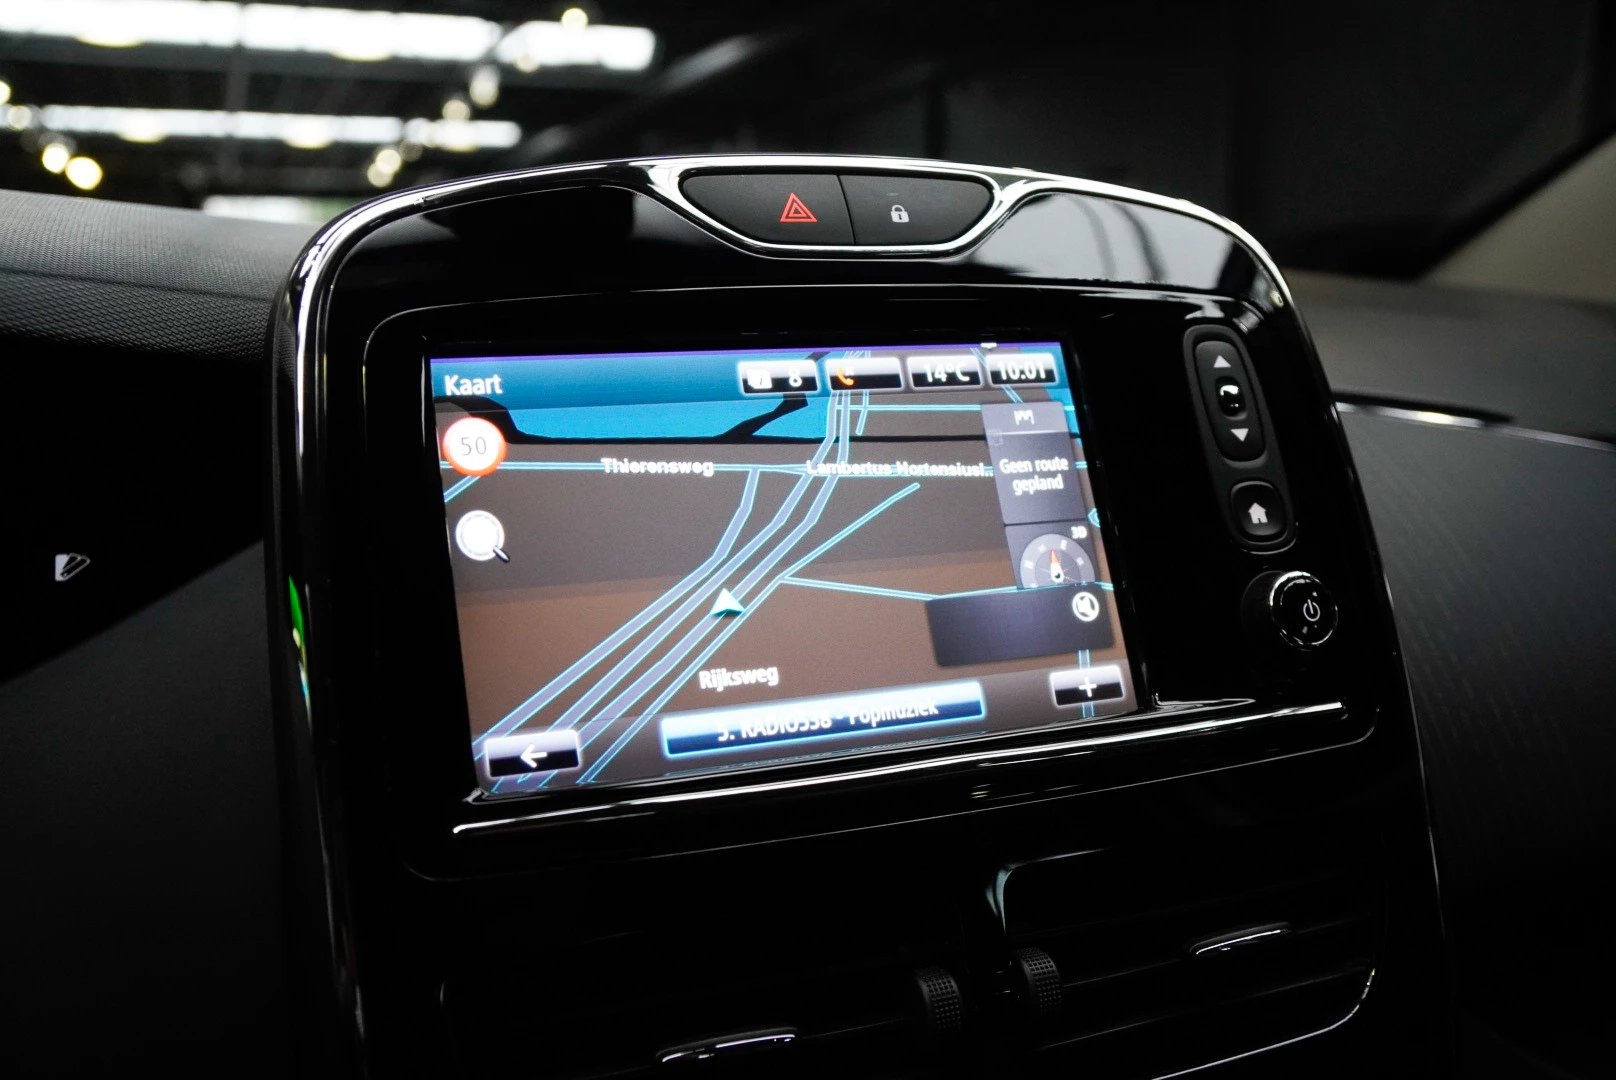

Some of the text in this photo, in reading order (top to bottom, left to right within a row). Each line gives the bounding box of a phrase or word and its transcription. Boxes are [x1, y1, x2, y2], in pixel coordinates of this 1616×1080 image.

[788, 367, 803, 388] 8
[998, 360, 1046, 381] 10:01
[444, 374, 503, 396] Kaart
[460, 436, 487, 456] 50
[600, 457, 715, 478] Thierensweg
[806, 460, 892, 476] Lambertus
[999, 456, 1069, 474] Geen route
[1012, 473, 1065, 496] gepland
[1070, 525, 1087, 539] 3D
[699, 666, 780, 692] Rijksweg
